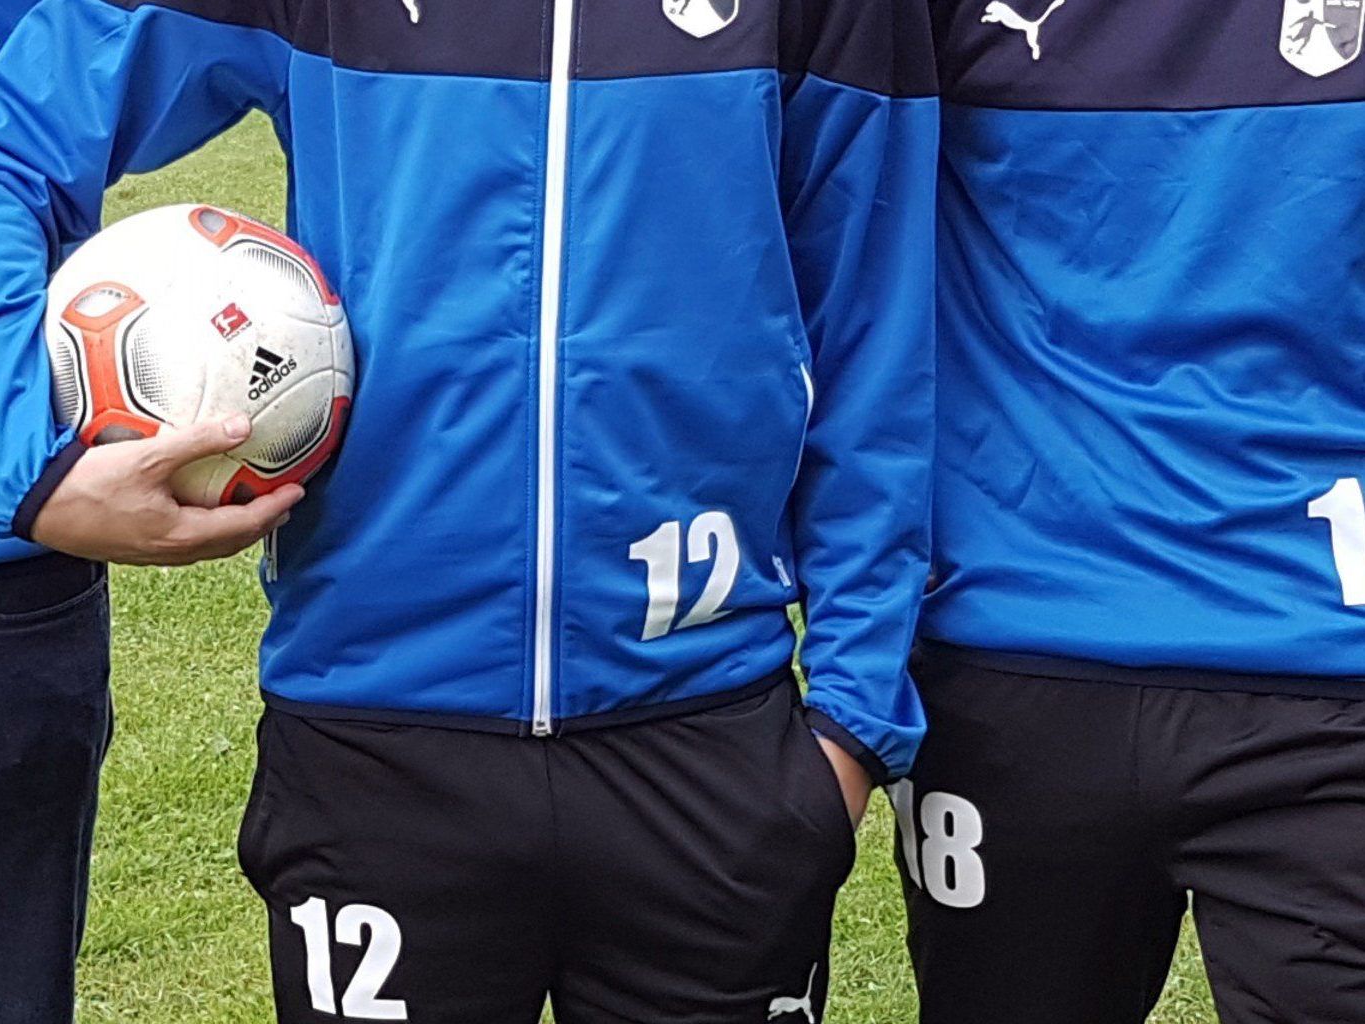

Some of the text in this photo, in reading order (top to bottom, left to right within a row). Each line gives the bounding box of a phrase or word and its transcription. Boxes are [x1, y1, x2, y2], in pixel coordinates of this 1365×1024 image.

[248, 357, 297, 400] adidas
[629, 511, 739, 641] 12
[290, 896, 408, 1020] 12
